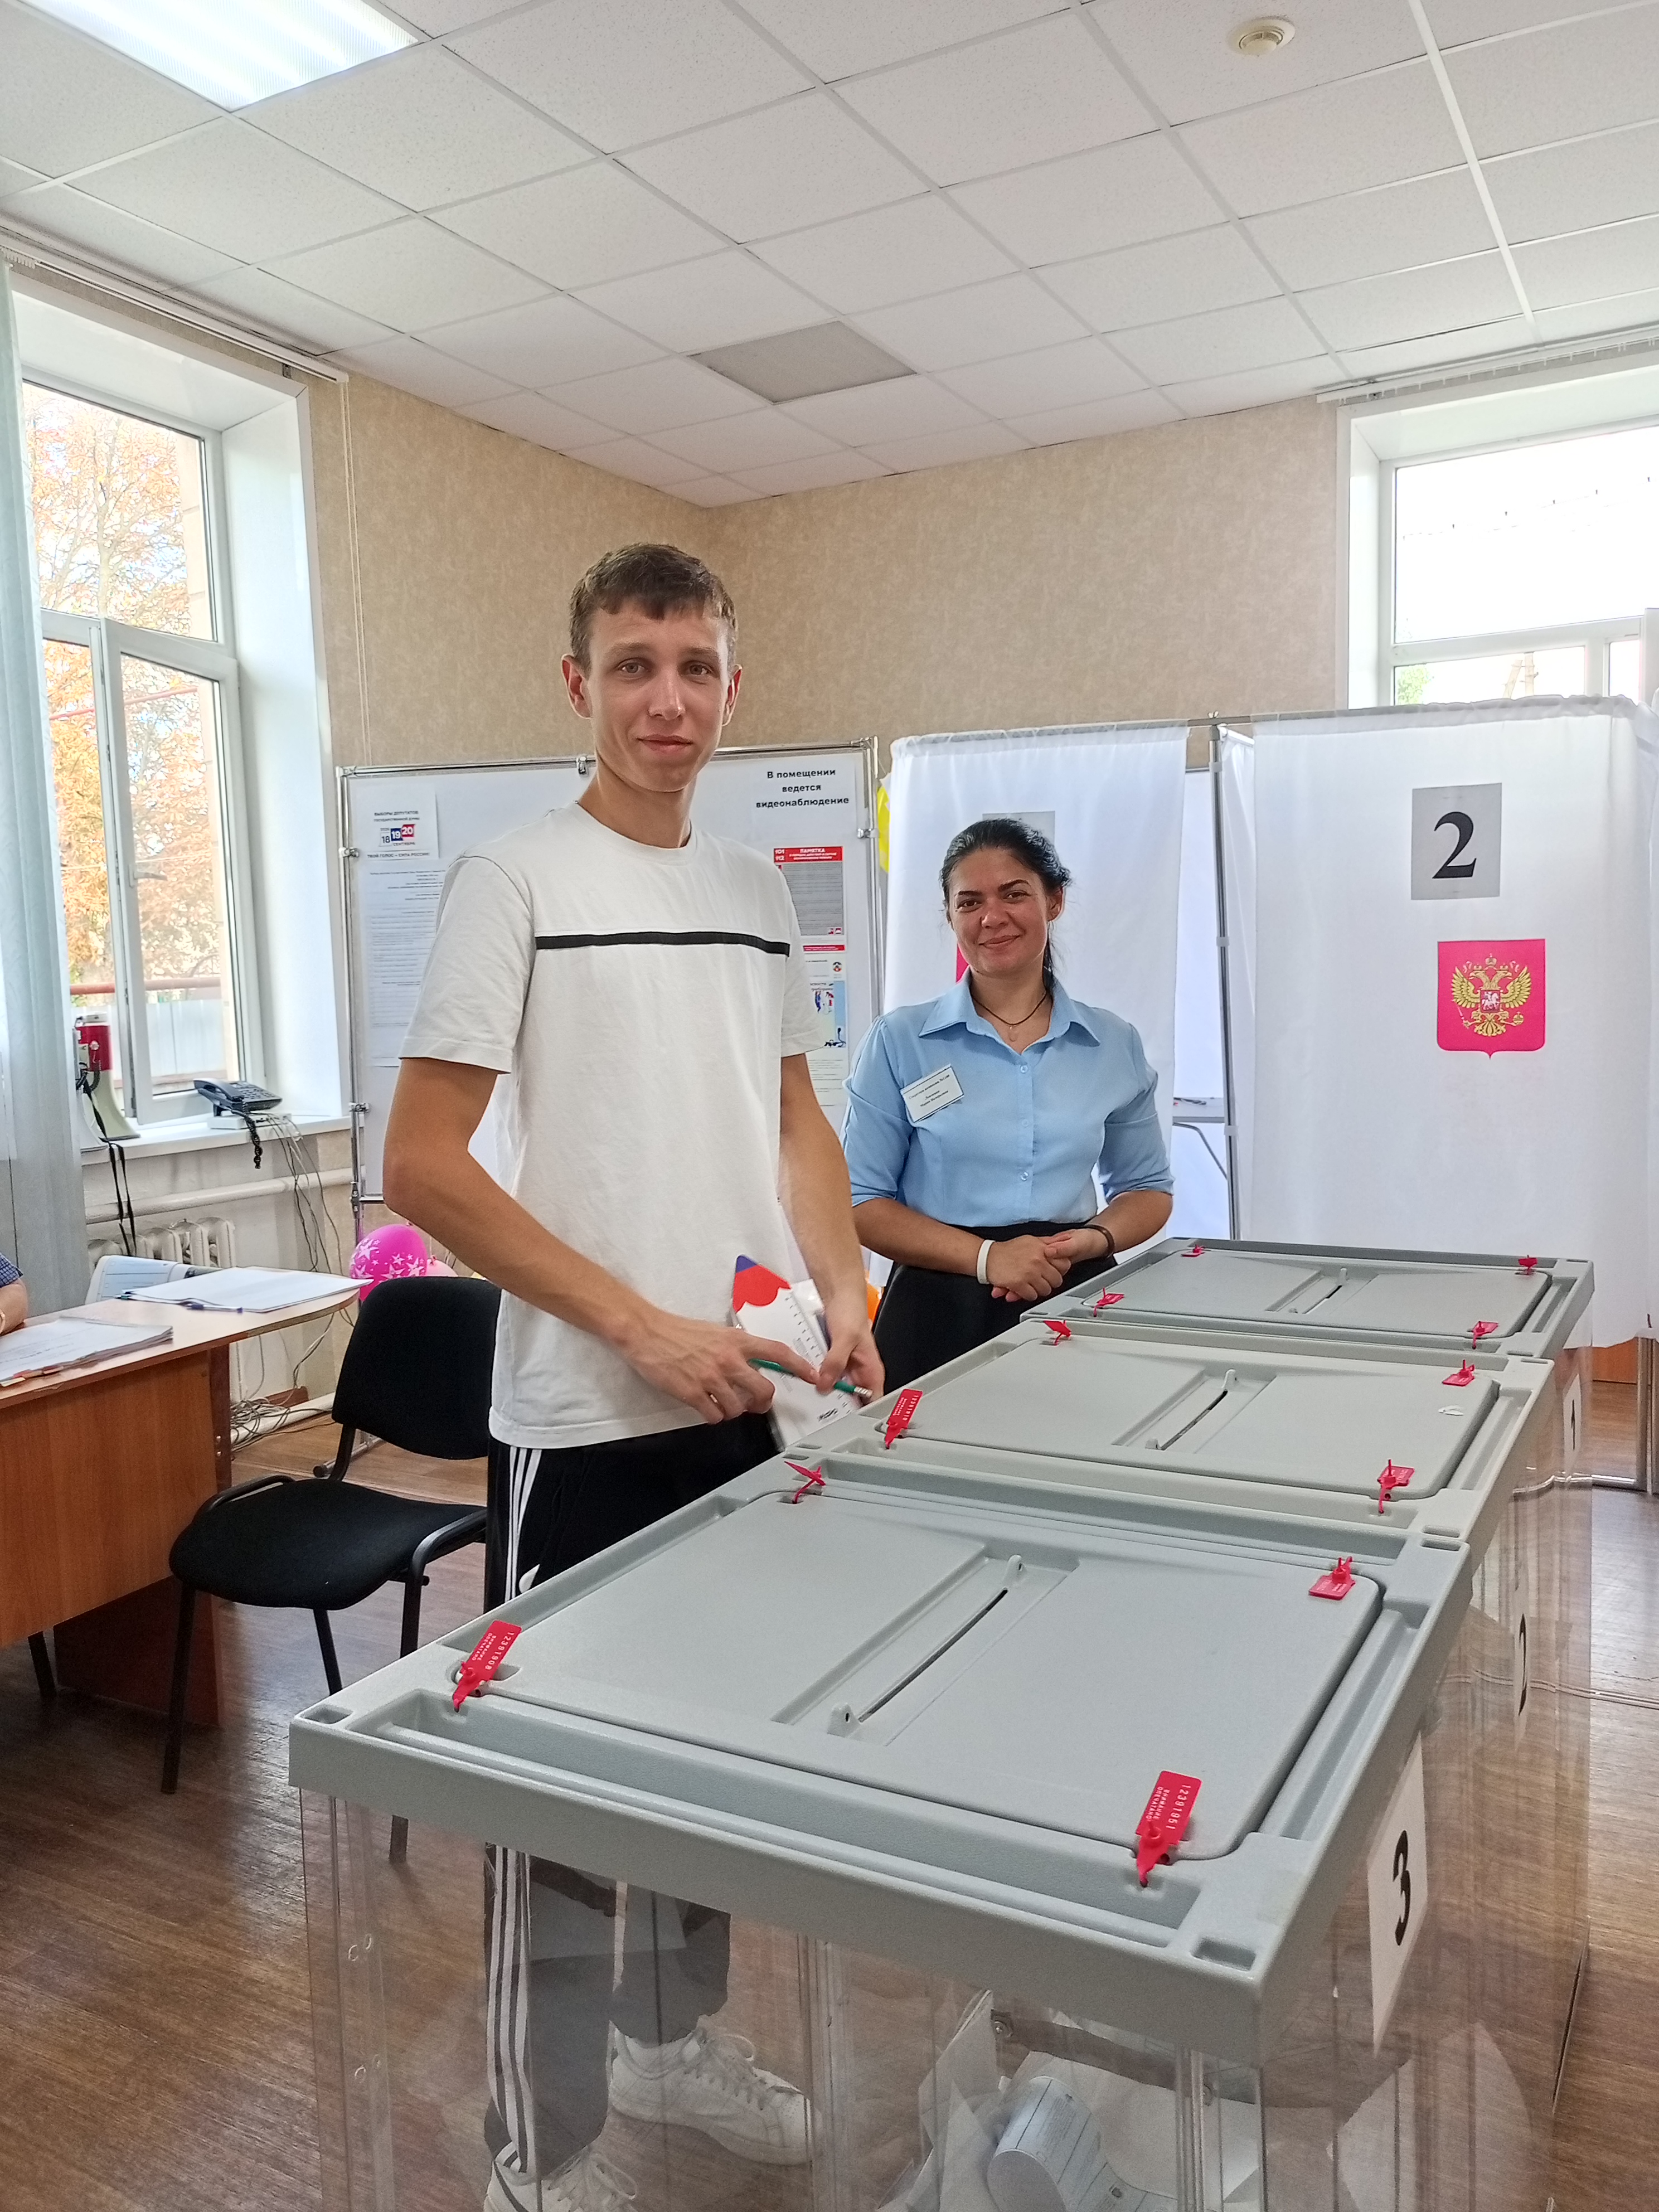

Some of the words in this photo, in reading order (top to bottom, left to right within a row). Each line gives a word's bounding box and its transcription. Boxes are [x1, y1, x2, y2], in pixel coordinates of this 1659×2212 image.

[777, 769, 836, 778] помещении
[782, 784, 821, 793] ведется
[756, 798, 850, 808] видеонаблюдение
[391, 831, 401, 839] 19
[402, 827, 413, 835] 20
[1432, 811, 1477, 879] 2
[1518, 1613, 1527, 1716] 2
[1393, 1830, 1411, 1946] 3
